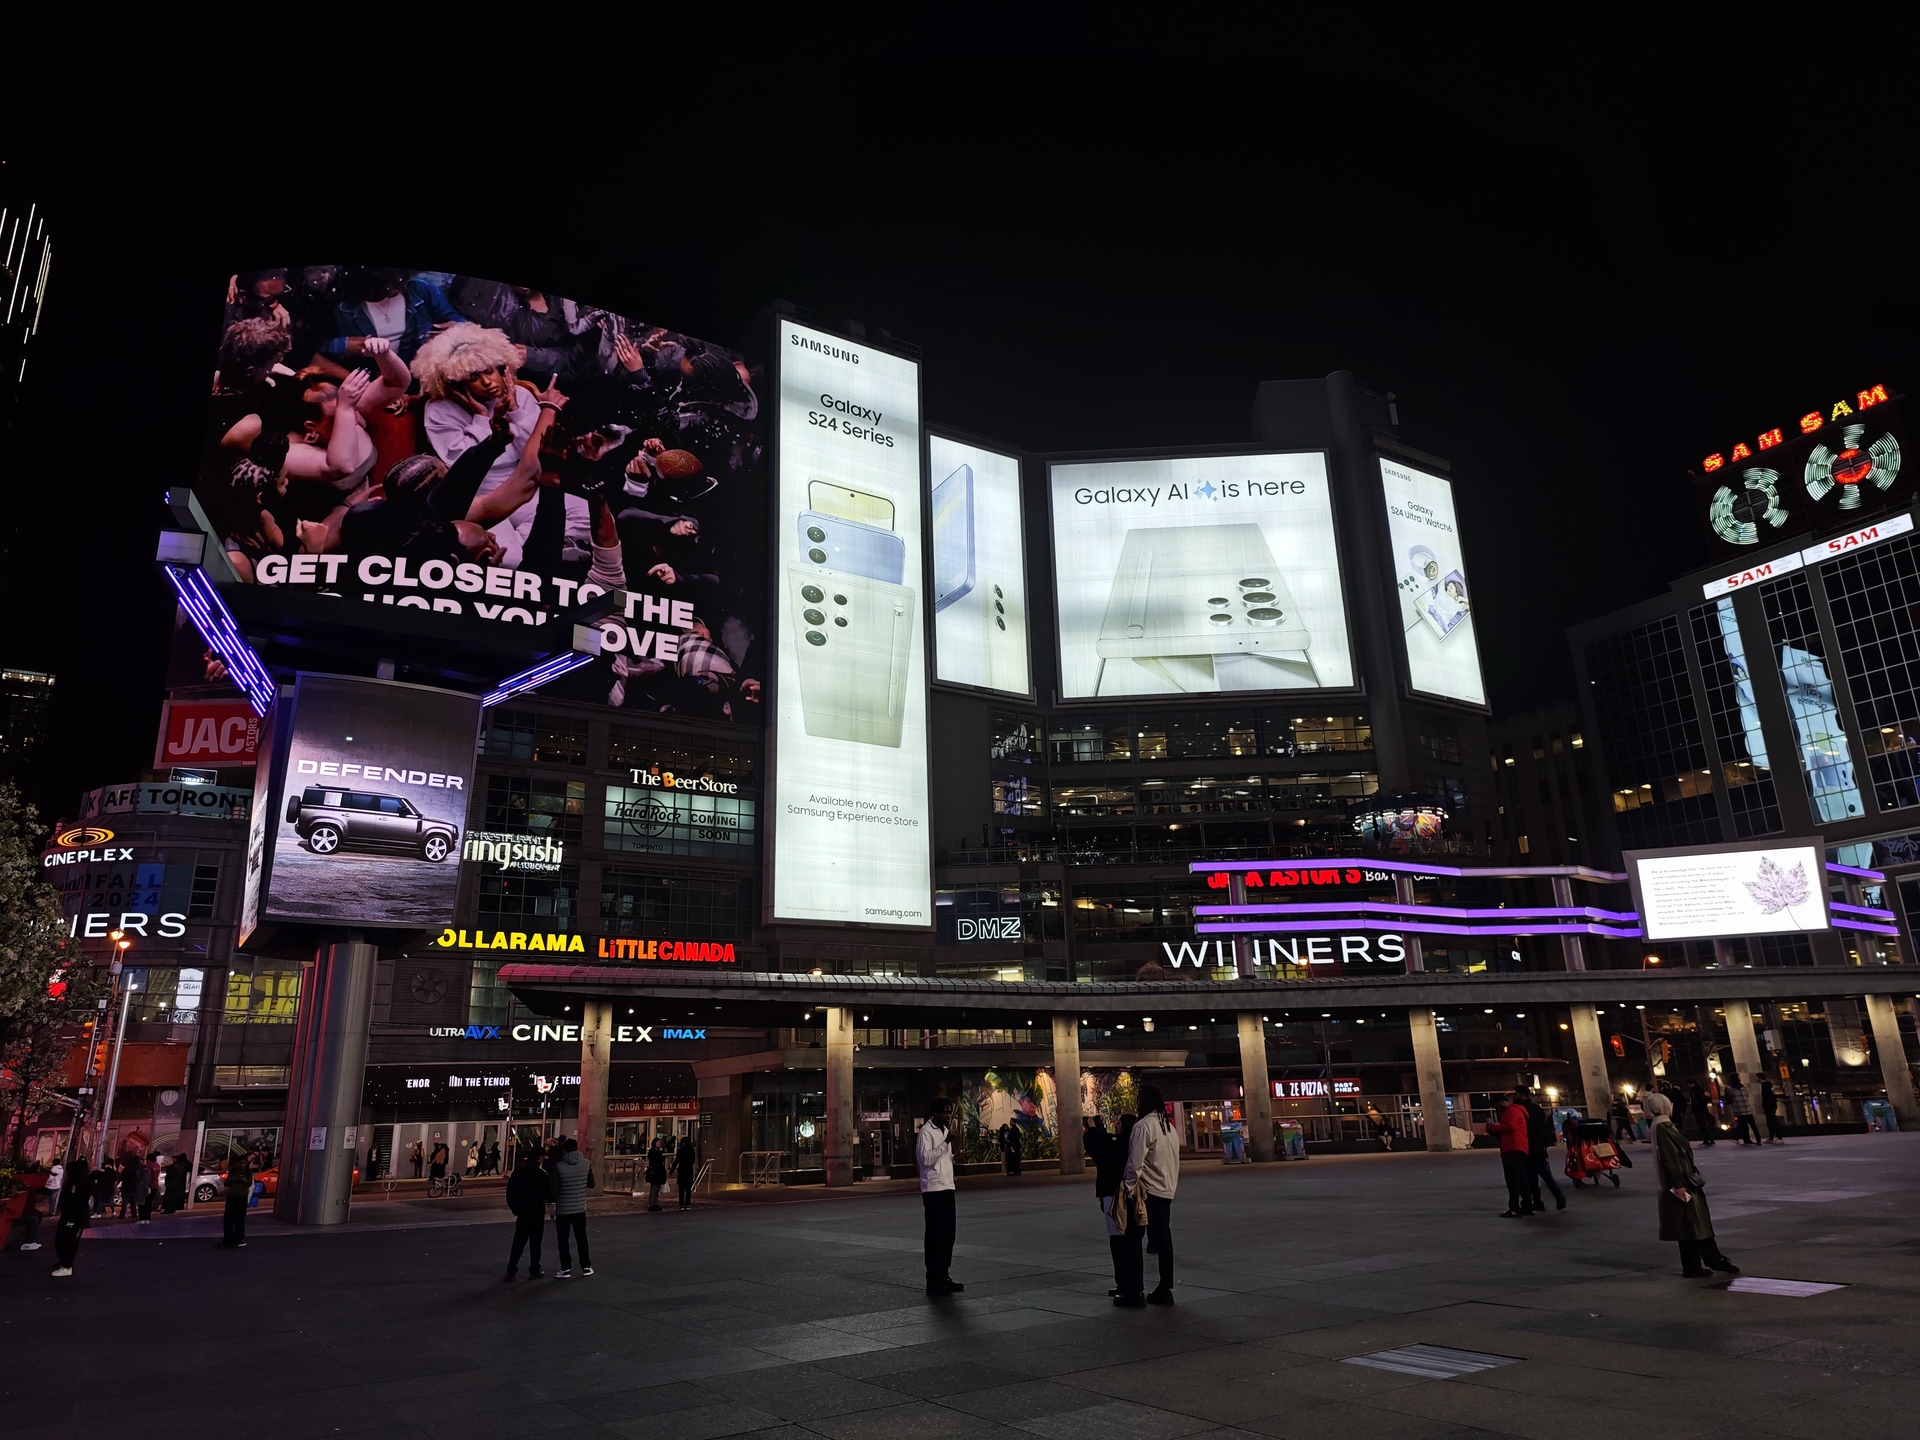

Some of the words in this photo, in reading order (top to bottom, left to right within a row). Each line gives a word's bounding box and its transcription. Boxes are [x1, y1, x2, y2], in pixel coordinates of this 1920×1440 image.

[790, 334, 860, 364] SAMSUNG
[820, 393, 882, 426] Galaxy
[808, 411, 838, 432] S24
[842, 421, 894, 448] Series
[1702, 427, 1784, 473] SAM
[1800, 383, 1888, 434] SAM
[1384, 467, 1412, 482] SAMSUNG
[1074, 486, 1161, 508] Galaxy
[1167, 482, 1189, 500] AI
[1221, 480, 1240, 498] is
[1248, 479, 1306, 497] here
[1390, 506, 1404, 517] S24
[1404, 510, 1422, 523] Ultra
[1424, 517, 1453, 533] Watch6
[1407, 501, 1434, 518] Galaxy
[1828, 527, 1880, 554] SAM
[1727, 564, 1772, 588] SAM
[256, 554, 348, 585] GET
[358, 555, 541, 602] CLOSER
[620, 590, 694, 630] THE
[600, 623, 679, 662] OVE
[168, 716, 248, 755] JAC
[245, 718, 258, 753] ASTORS
[297, 759, 464, 790] DEFENDER
[630, 768, 661, 786] The
[662, 772, 700, 790] Beer
[700, 776, 738, 794] Store
[97, 788, 142, 808] AFE
[148, 788, 252, 808] TORONT
[809, 794, 854, 808] Available
[856, 800, 878, 810] now
[879, 803, 890, 812] at
[892, 804, 898, 812] a
[691, 813, 736, 827] COMING
[787, 804, 835, 820] Samsung
[837, 811, 892, 824] Experience
[894, 816, 918, 827] Store
[640, 823, 658, 831] CAFE
[698, 829, 731, 841] SOON
[632, 842, 664, 851] TORONTO
[44, 848, 134, 868] CINEPLEX
[91, 891, 160, 908] 2024
[864, 906, 922, 919] samsung.com
[958, 917, 1021, 940] DMZ
[437, 928, 585, 952] OLLARAMA
[658, 941, 736, 962] CANADA
[512, 1024, 652, 1043] CINEEX
[662, 1028, 706, 1040] IMAX
[406, 1078, 430, 1088] ENOR
[465, 1077, 481, 1087] THE
[484, 1076, 510, 1086] TENOR
[561, 1076, 582, 1086] TENO
[1275, 1082, 1300, 1097] BLZE
[1300, 1082, 1324, 1096] PIZZA
[608, 1102, 640, 1112] CANADA
